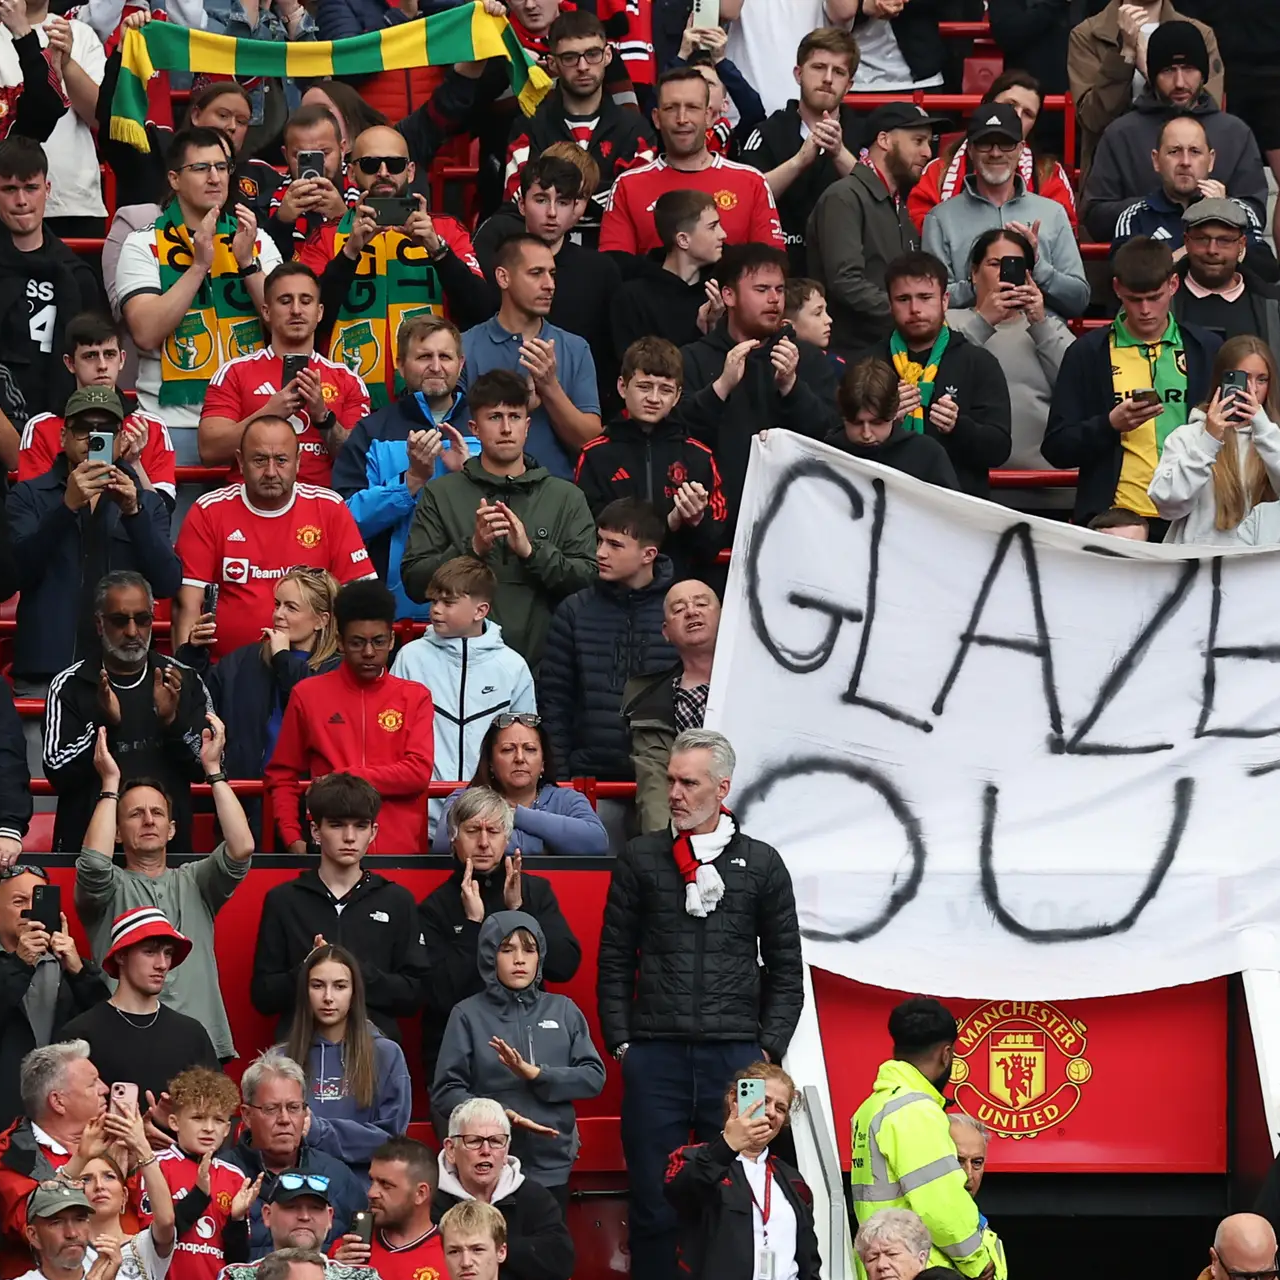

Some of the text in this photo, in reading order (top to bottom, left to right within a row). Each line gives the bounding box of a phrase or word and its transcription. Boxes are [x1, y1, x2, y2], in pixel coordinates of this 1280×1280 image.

[28, 304, 57, 353] 4
[958, 1000, 1077, 1052] MANCHESTER
[975, 1103, 1059, 1132] UNITED
